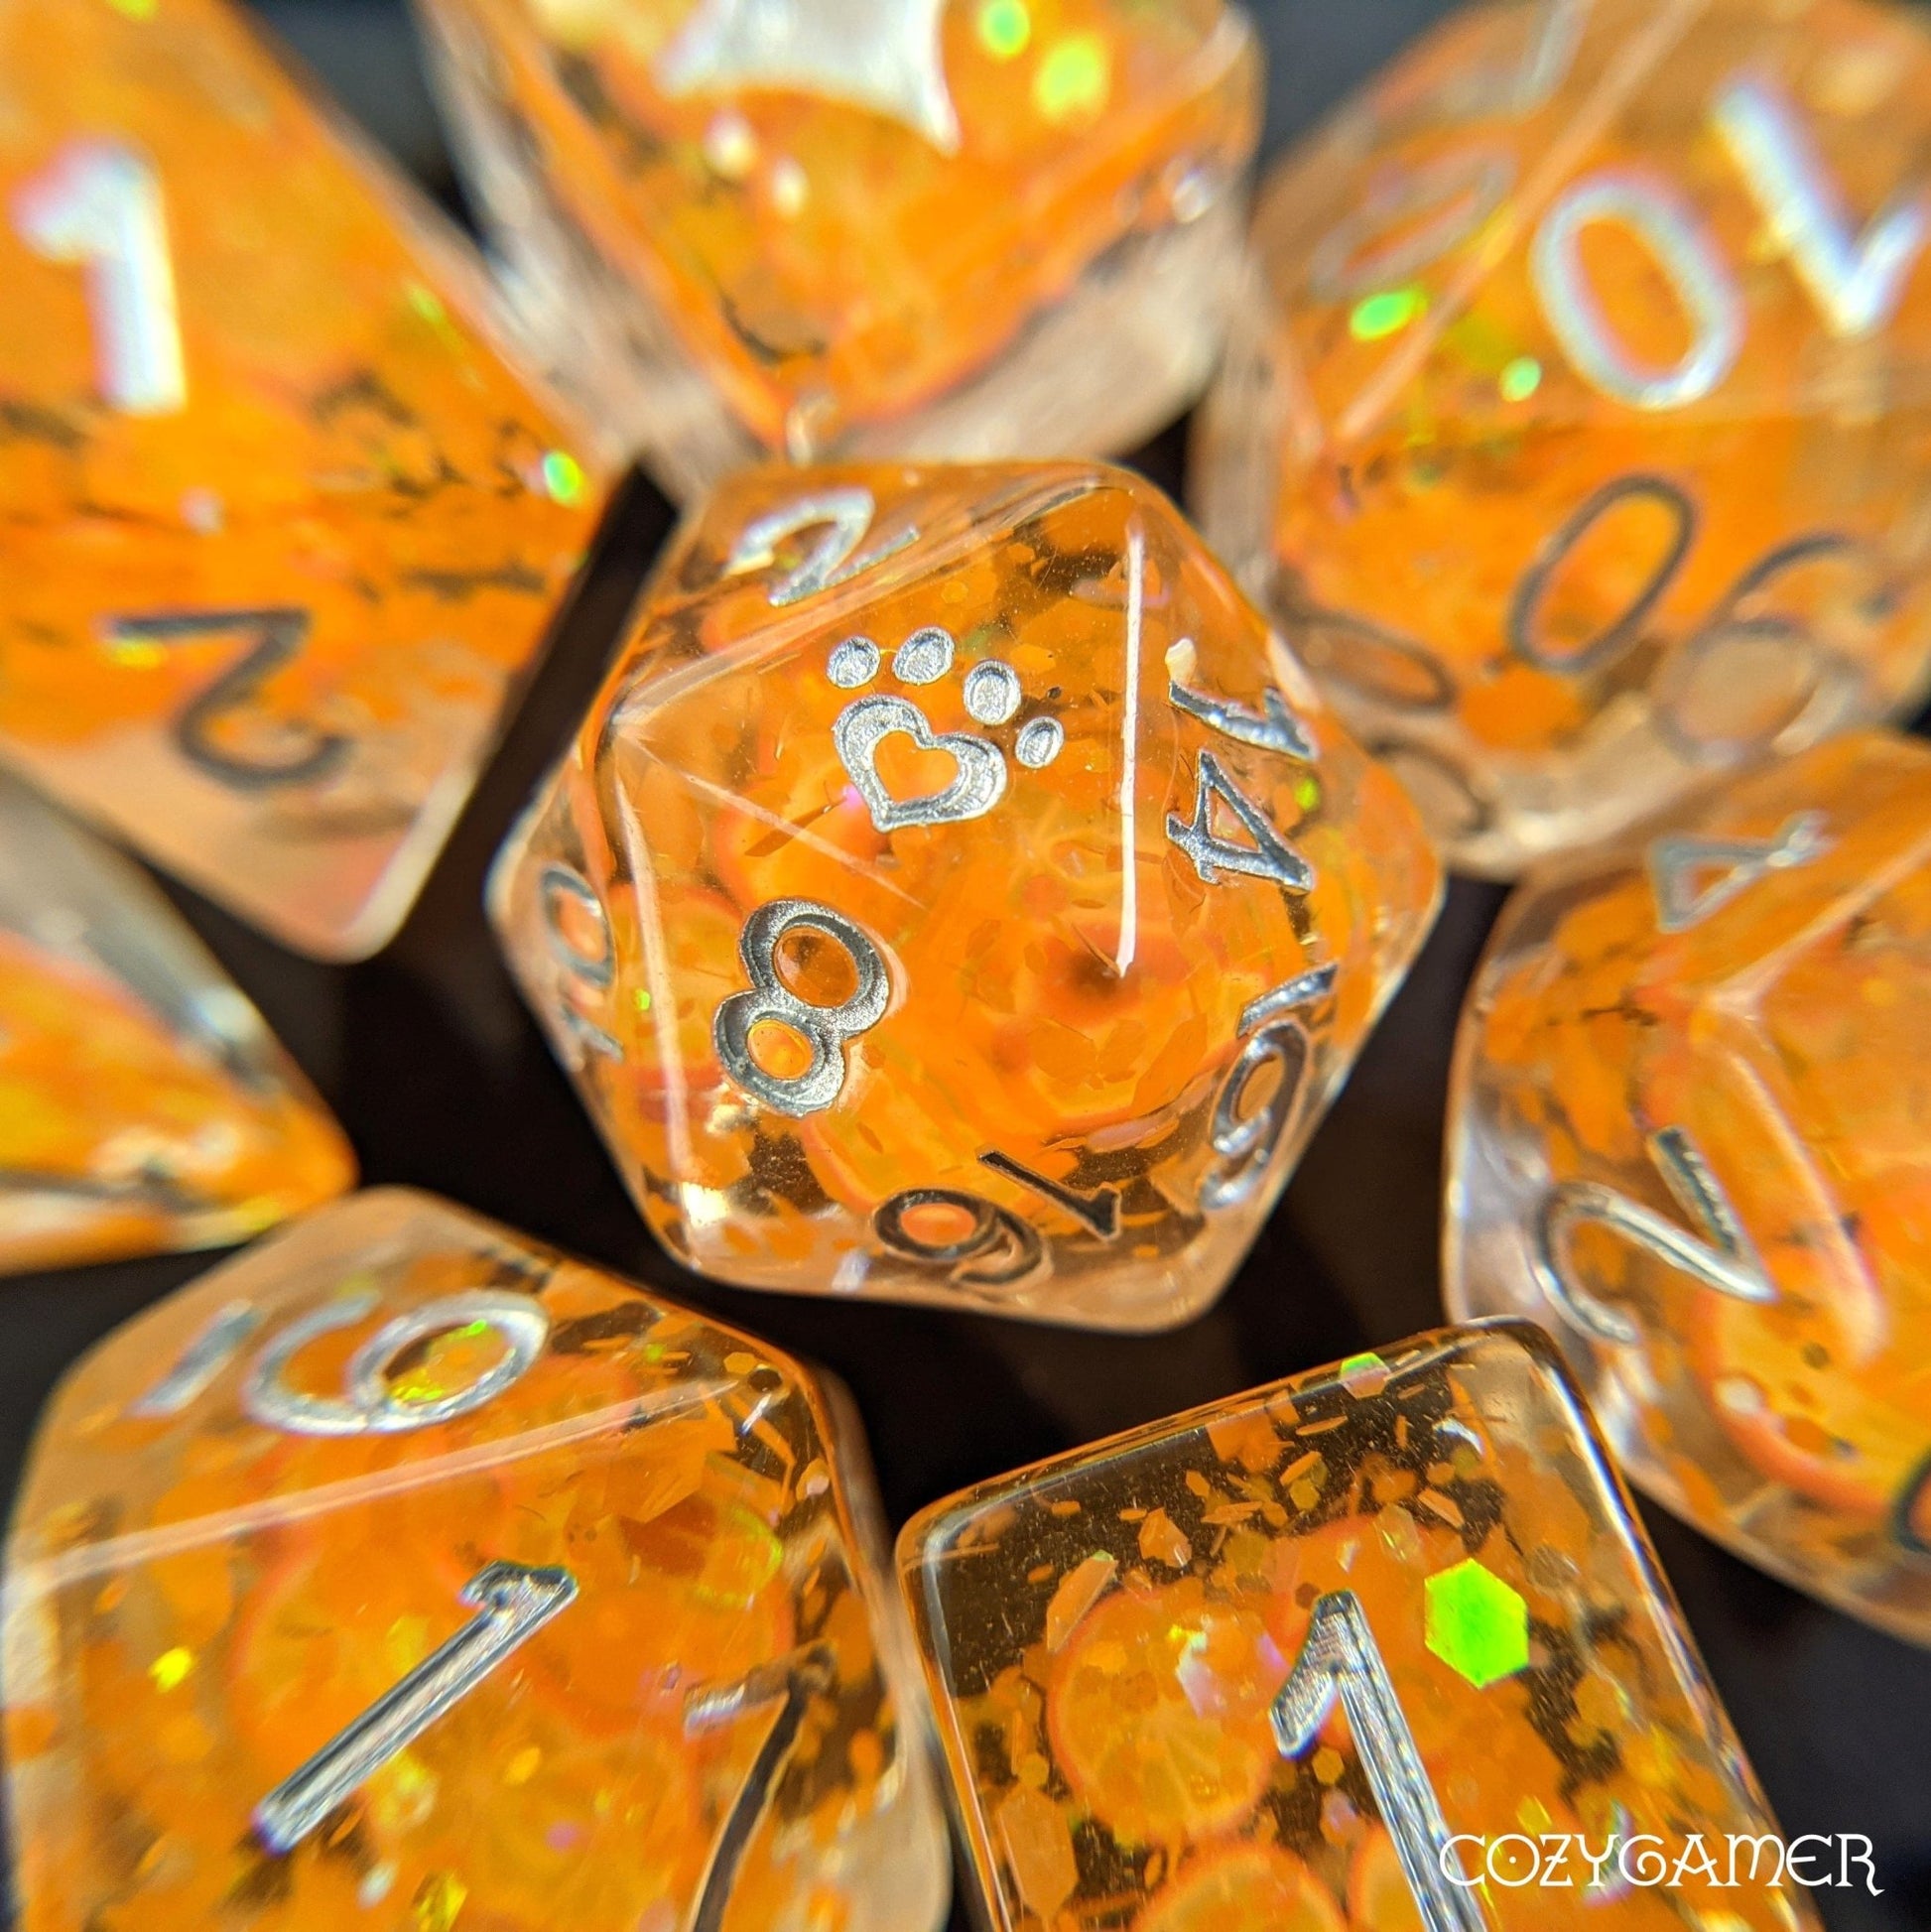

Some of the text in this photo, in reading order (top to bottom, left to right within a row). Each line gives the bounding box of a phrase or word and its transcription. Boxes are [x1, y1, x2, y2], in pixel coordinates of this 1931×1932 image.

[18, 137, 189, 415] 1
[720, 484, 921, 608] 2
[1165, 679, 1322, 893] 14
[712, 897, 891, 1119] 8
[1534, 1126, 1778, 1346] 2
[250, 1558, 579, 1854] 1
[1268, 1588, 1490, 1932] 1
